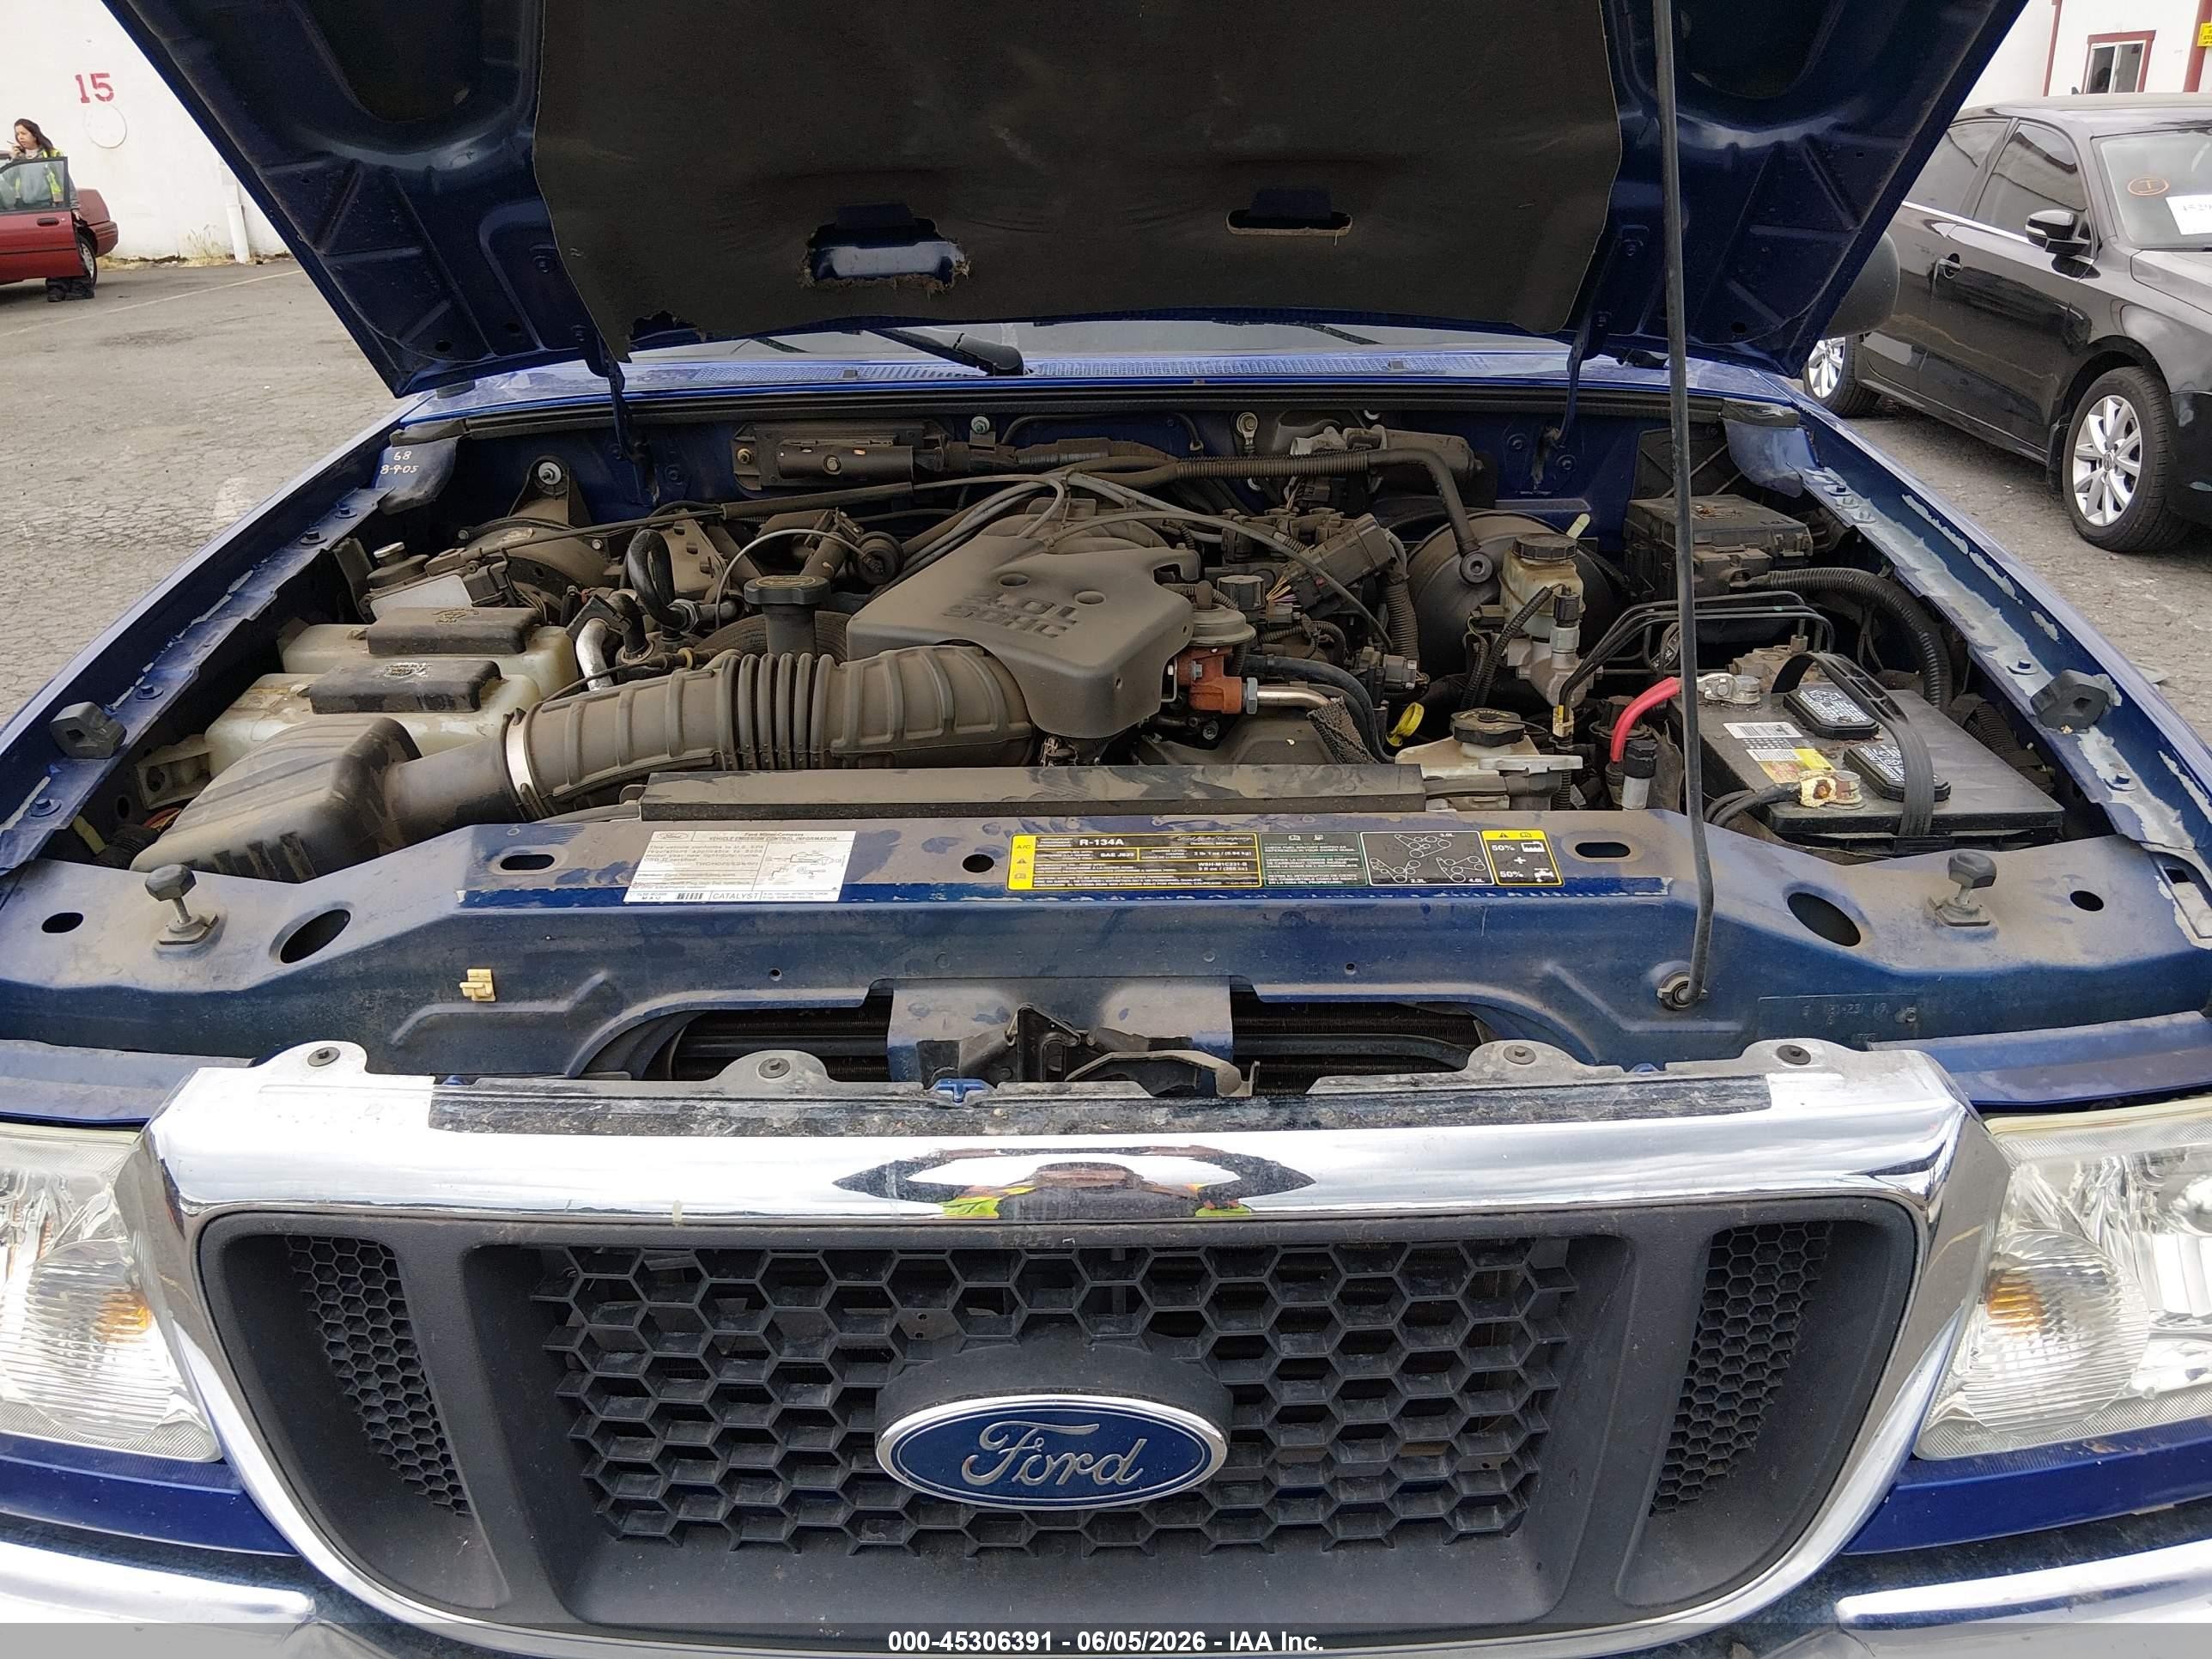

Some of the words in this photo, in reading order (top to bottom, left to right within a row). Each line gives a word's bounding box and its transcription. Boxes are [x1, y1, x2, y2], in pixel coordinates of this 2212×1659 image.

[75, 72, 115, 104] 15
[393, 451, 412, 461] 68
[380, 464, 419, 475] 8-9-05
[713, 892, 761, 901] CATALYST
[961, 1420, 1148, 1486] Ford
